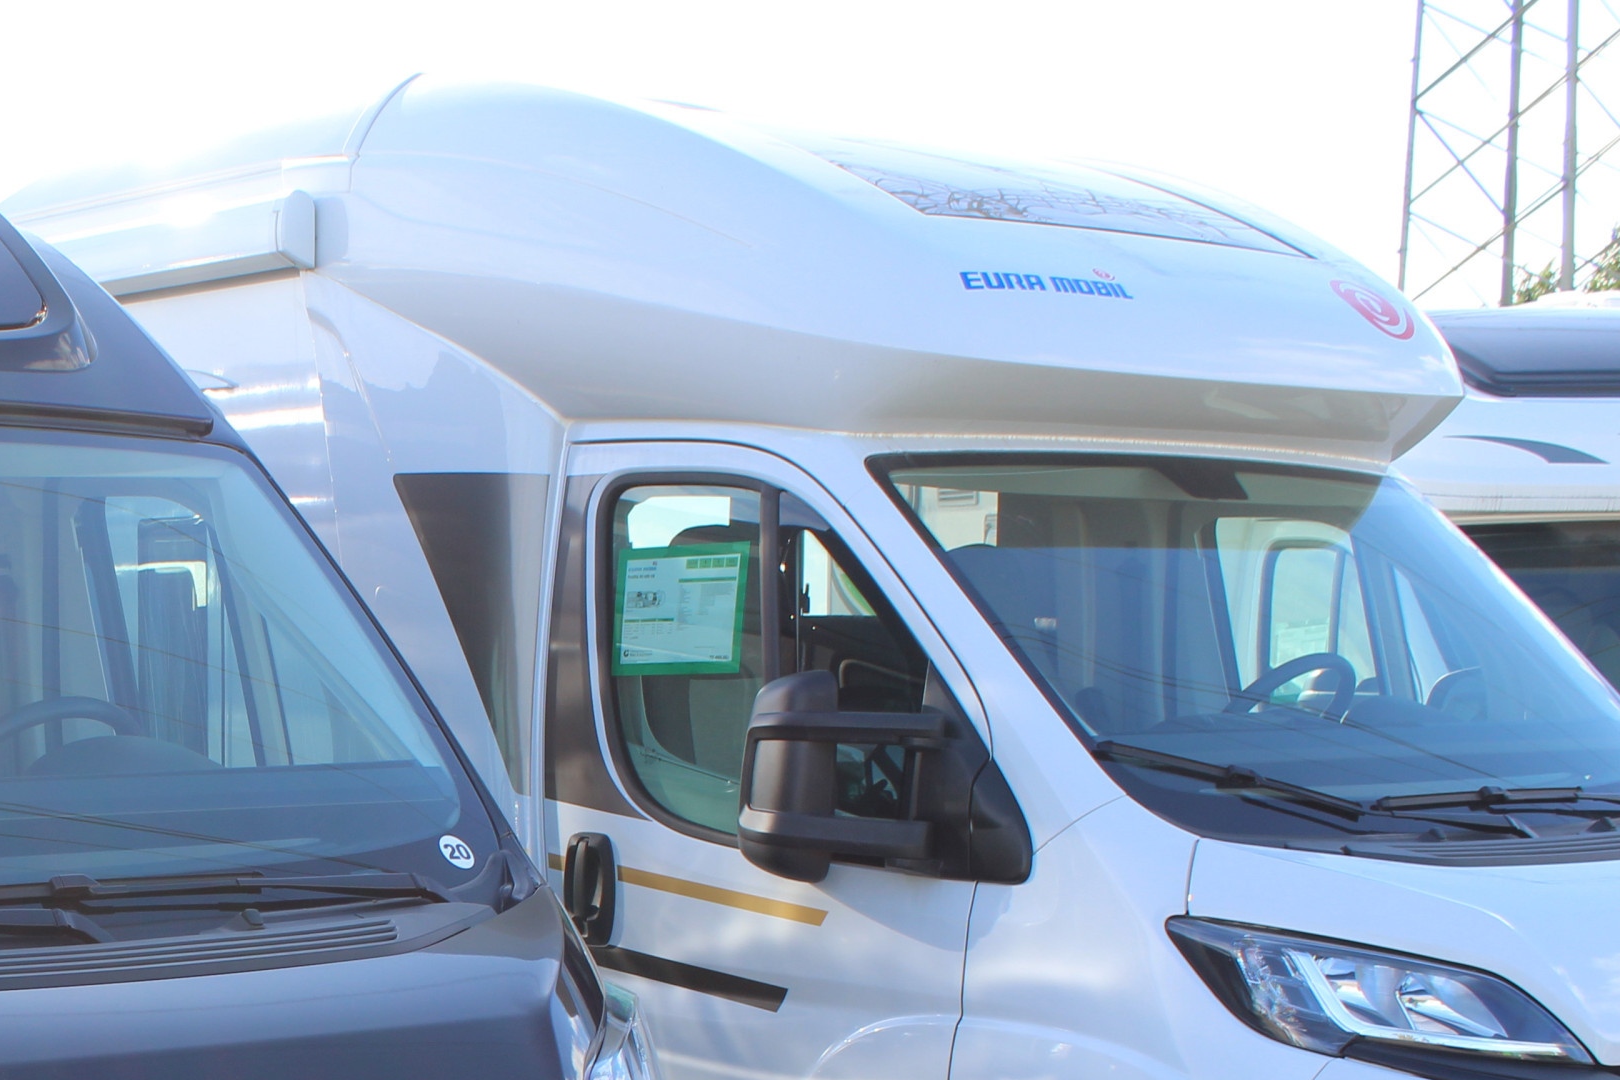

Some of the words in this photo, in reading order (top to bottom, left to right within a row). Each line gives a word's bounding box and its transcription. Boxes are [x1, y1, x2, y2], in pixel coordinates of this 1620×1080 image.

[959, 271, 1046, 291] EURA
[1049, 276, 1133, 300] MOBIL
[443, 843, 471, 860] 20
